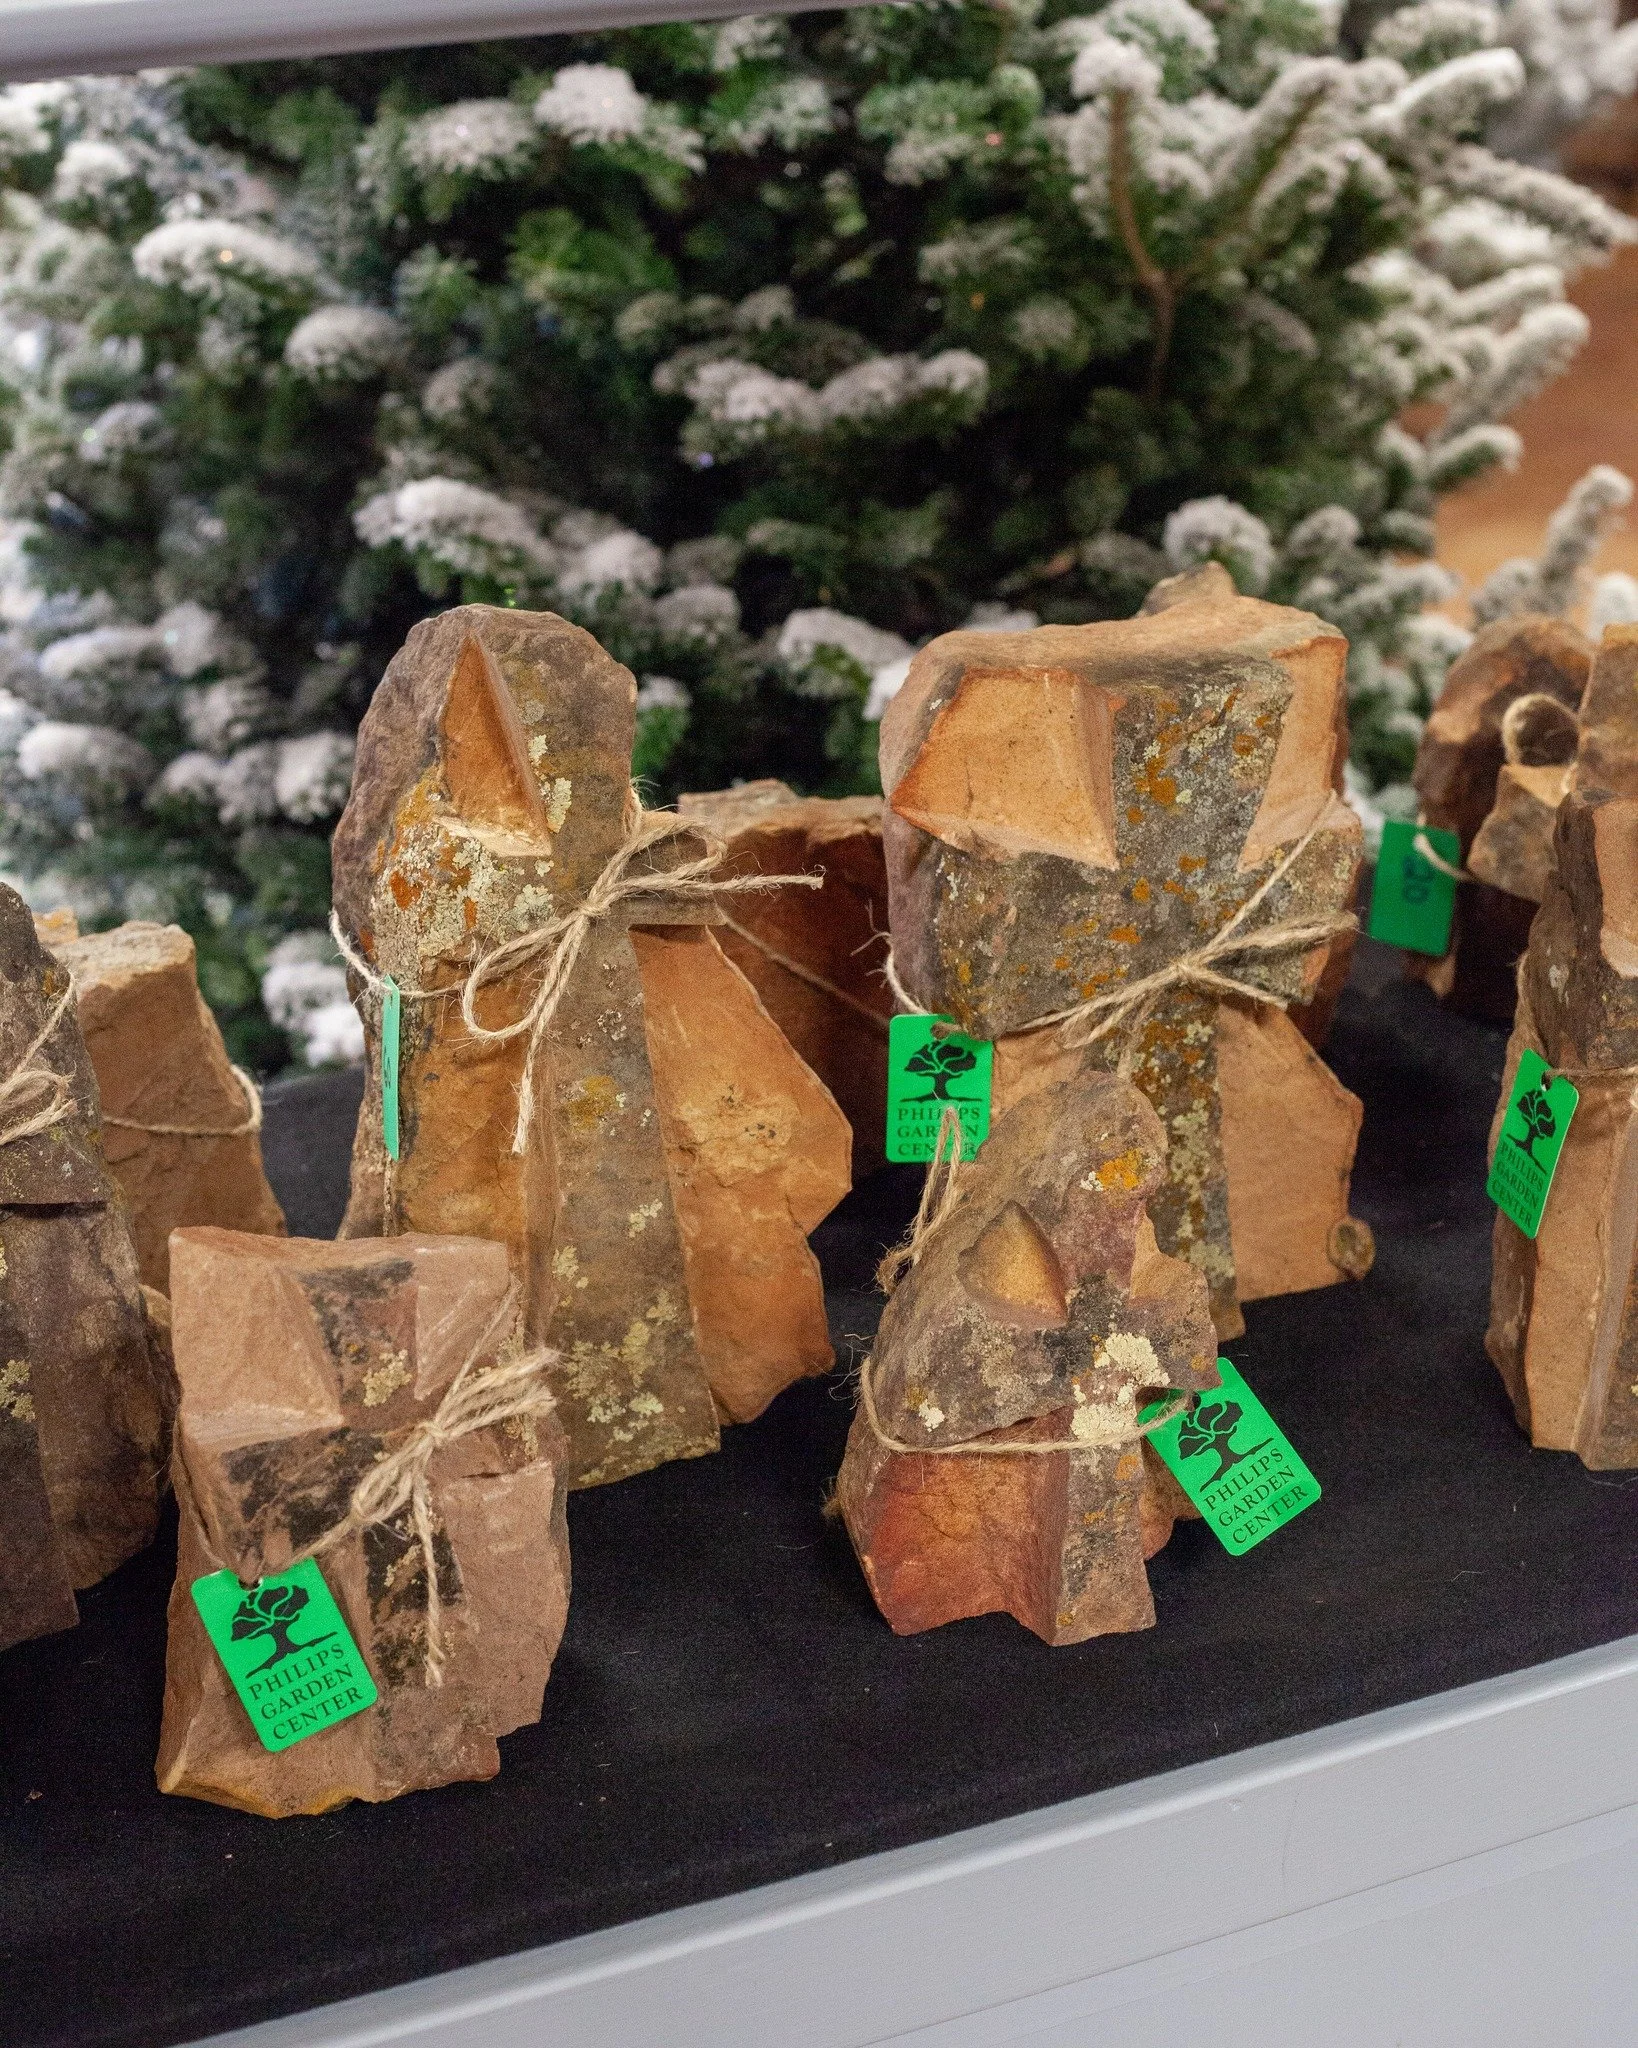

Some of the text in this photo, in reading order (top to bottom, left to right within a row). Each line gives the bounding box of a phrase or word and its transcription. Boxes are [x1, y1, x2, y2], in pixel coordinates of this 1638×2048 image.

[897, 1106, 980, 1121] PHIPS
[897, 1124, 979, 1138] GARN
[898, 1142, 976, 1156] CENR
[1501, 1140, 1544, 1193] PHILIPS
[1491, 1179, 1533, 1229] CENTER
[1496, 1160, 1539, 1210] GARDEN
[1203, 1447, 1284, 1512] PHILIPS
[1218, 1464, 1297, 1527] GARDEN
[1232, 1485, 1309, 1544] CENTER
[247, 1643, 345, 1701] PHILIPS
[260, 1662, 354, 1720] GARDEN
[272, 1686, 363, 1740] CENTER
